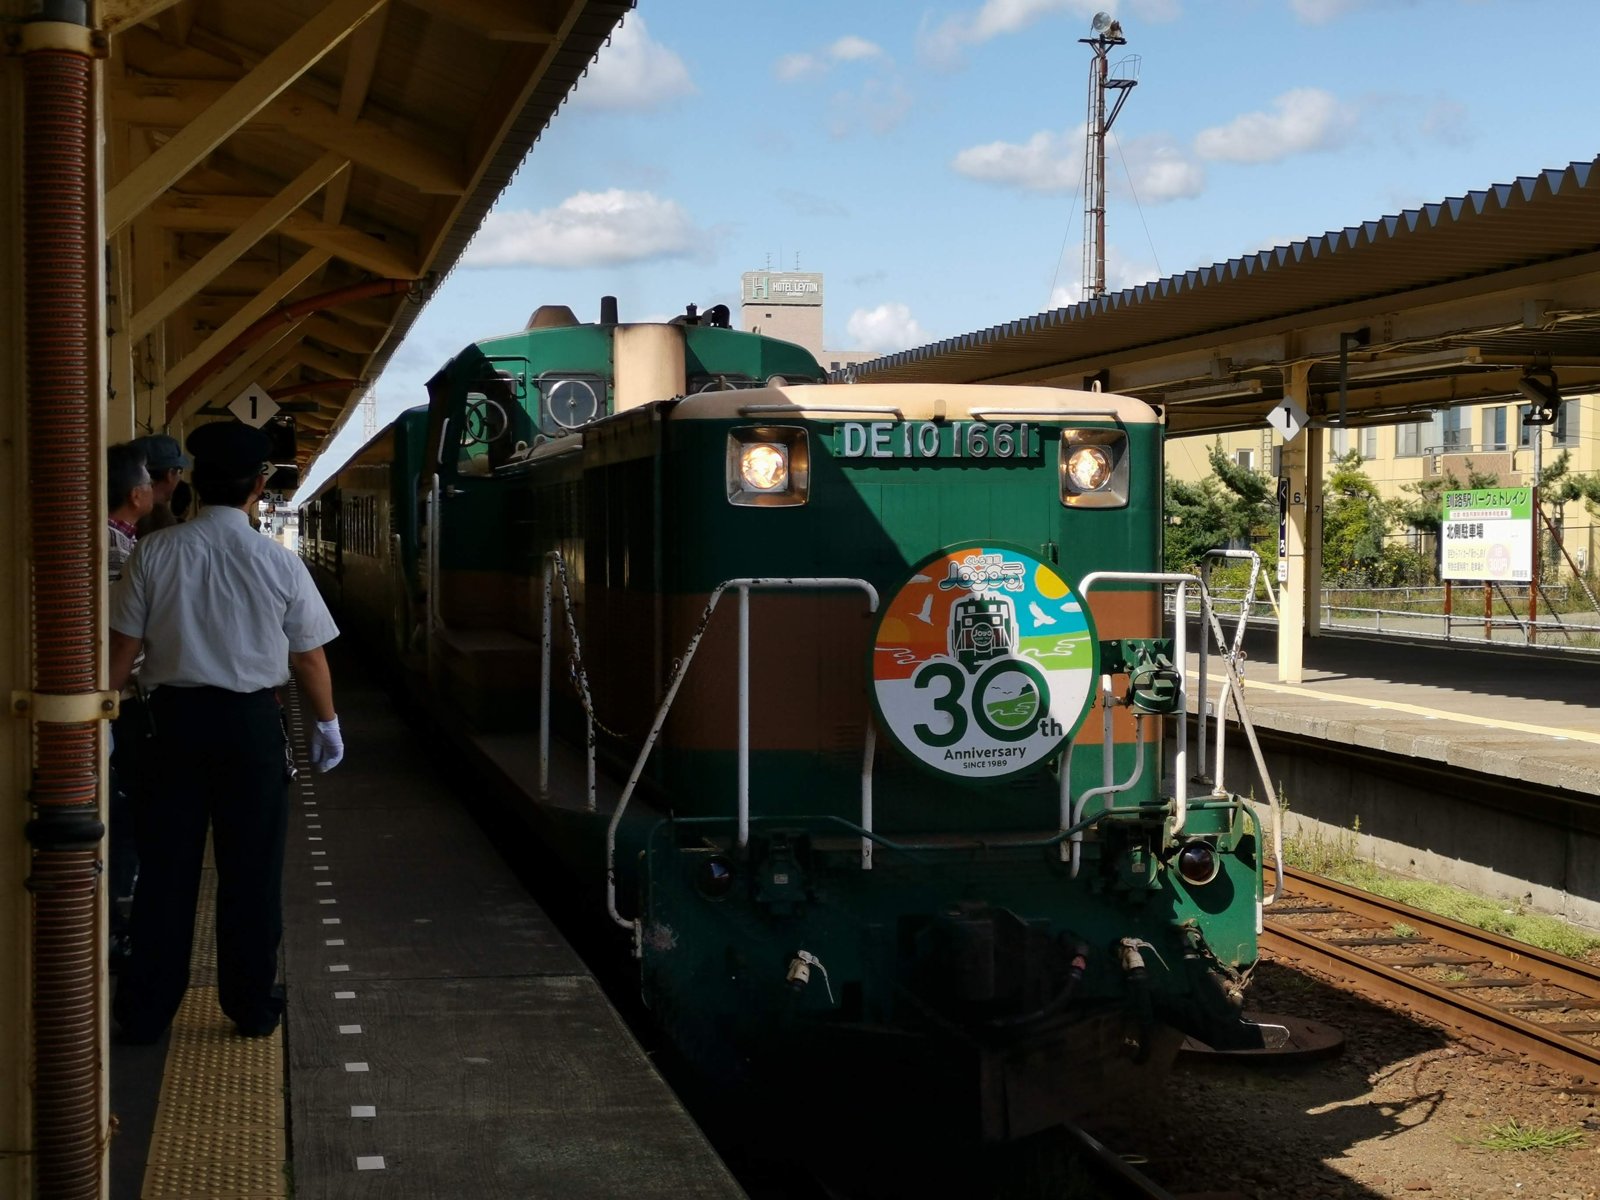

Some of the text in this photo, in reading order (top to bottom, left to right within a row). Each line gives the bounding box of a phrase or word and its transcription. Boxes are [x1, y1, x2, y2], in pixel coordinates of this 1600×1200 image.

[773, 282, 818, 292] HOTEL LEYTON
[249, 396, 257, 419] 1
[1284, 407, 1292, 428] 1
[844, 421, 1029, 458] DE 10 1661
[260, 464, 269, 475] 2
[1293, 491, 1301, 503] 6
[1314, 505, 1321, 513] 7
[1279, 486, 1287, 553] くしろ
[1446, 523, 1484, 539] 北側駐車場
[944, 746, 1027, 761] Anniversary
[963, 759, 1008, 769] SINCE 1989
